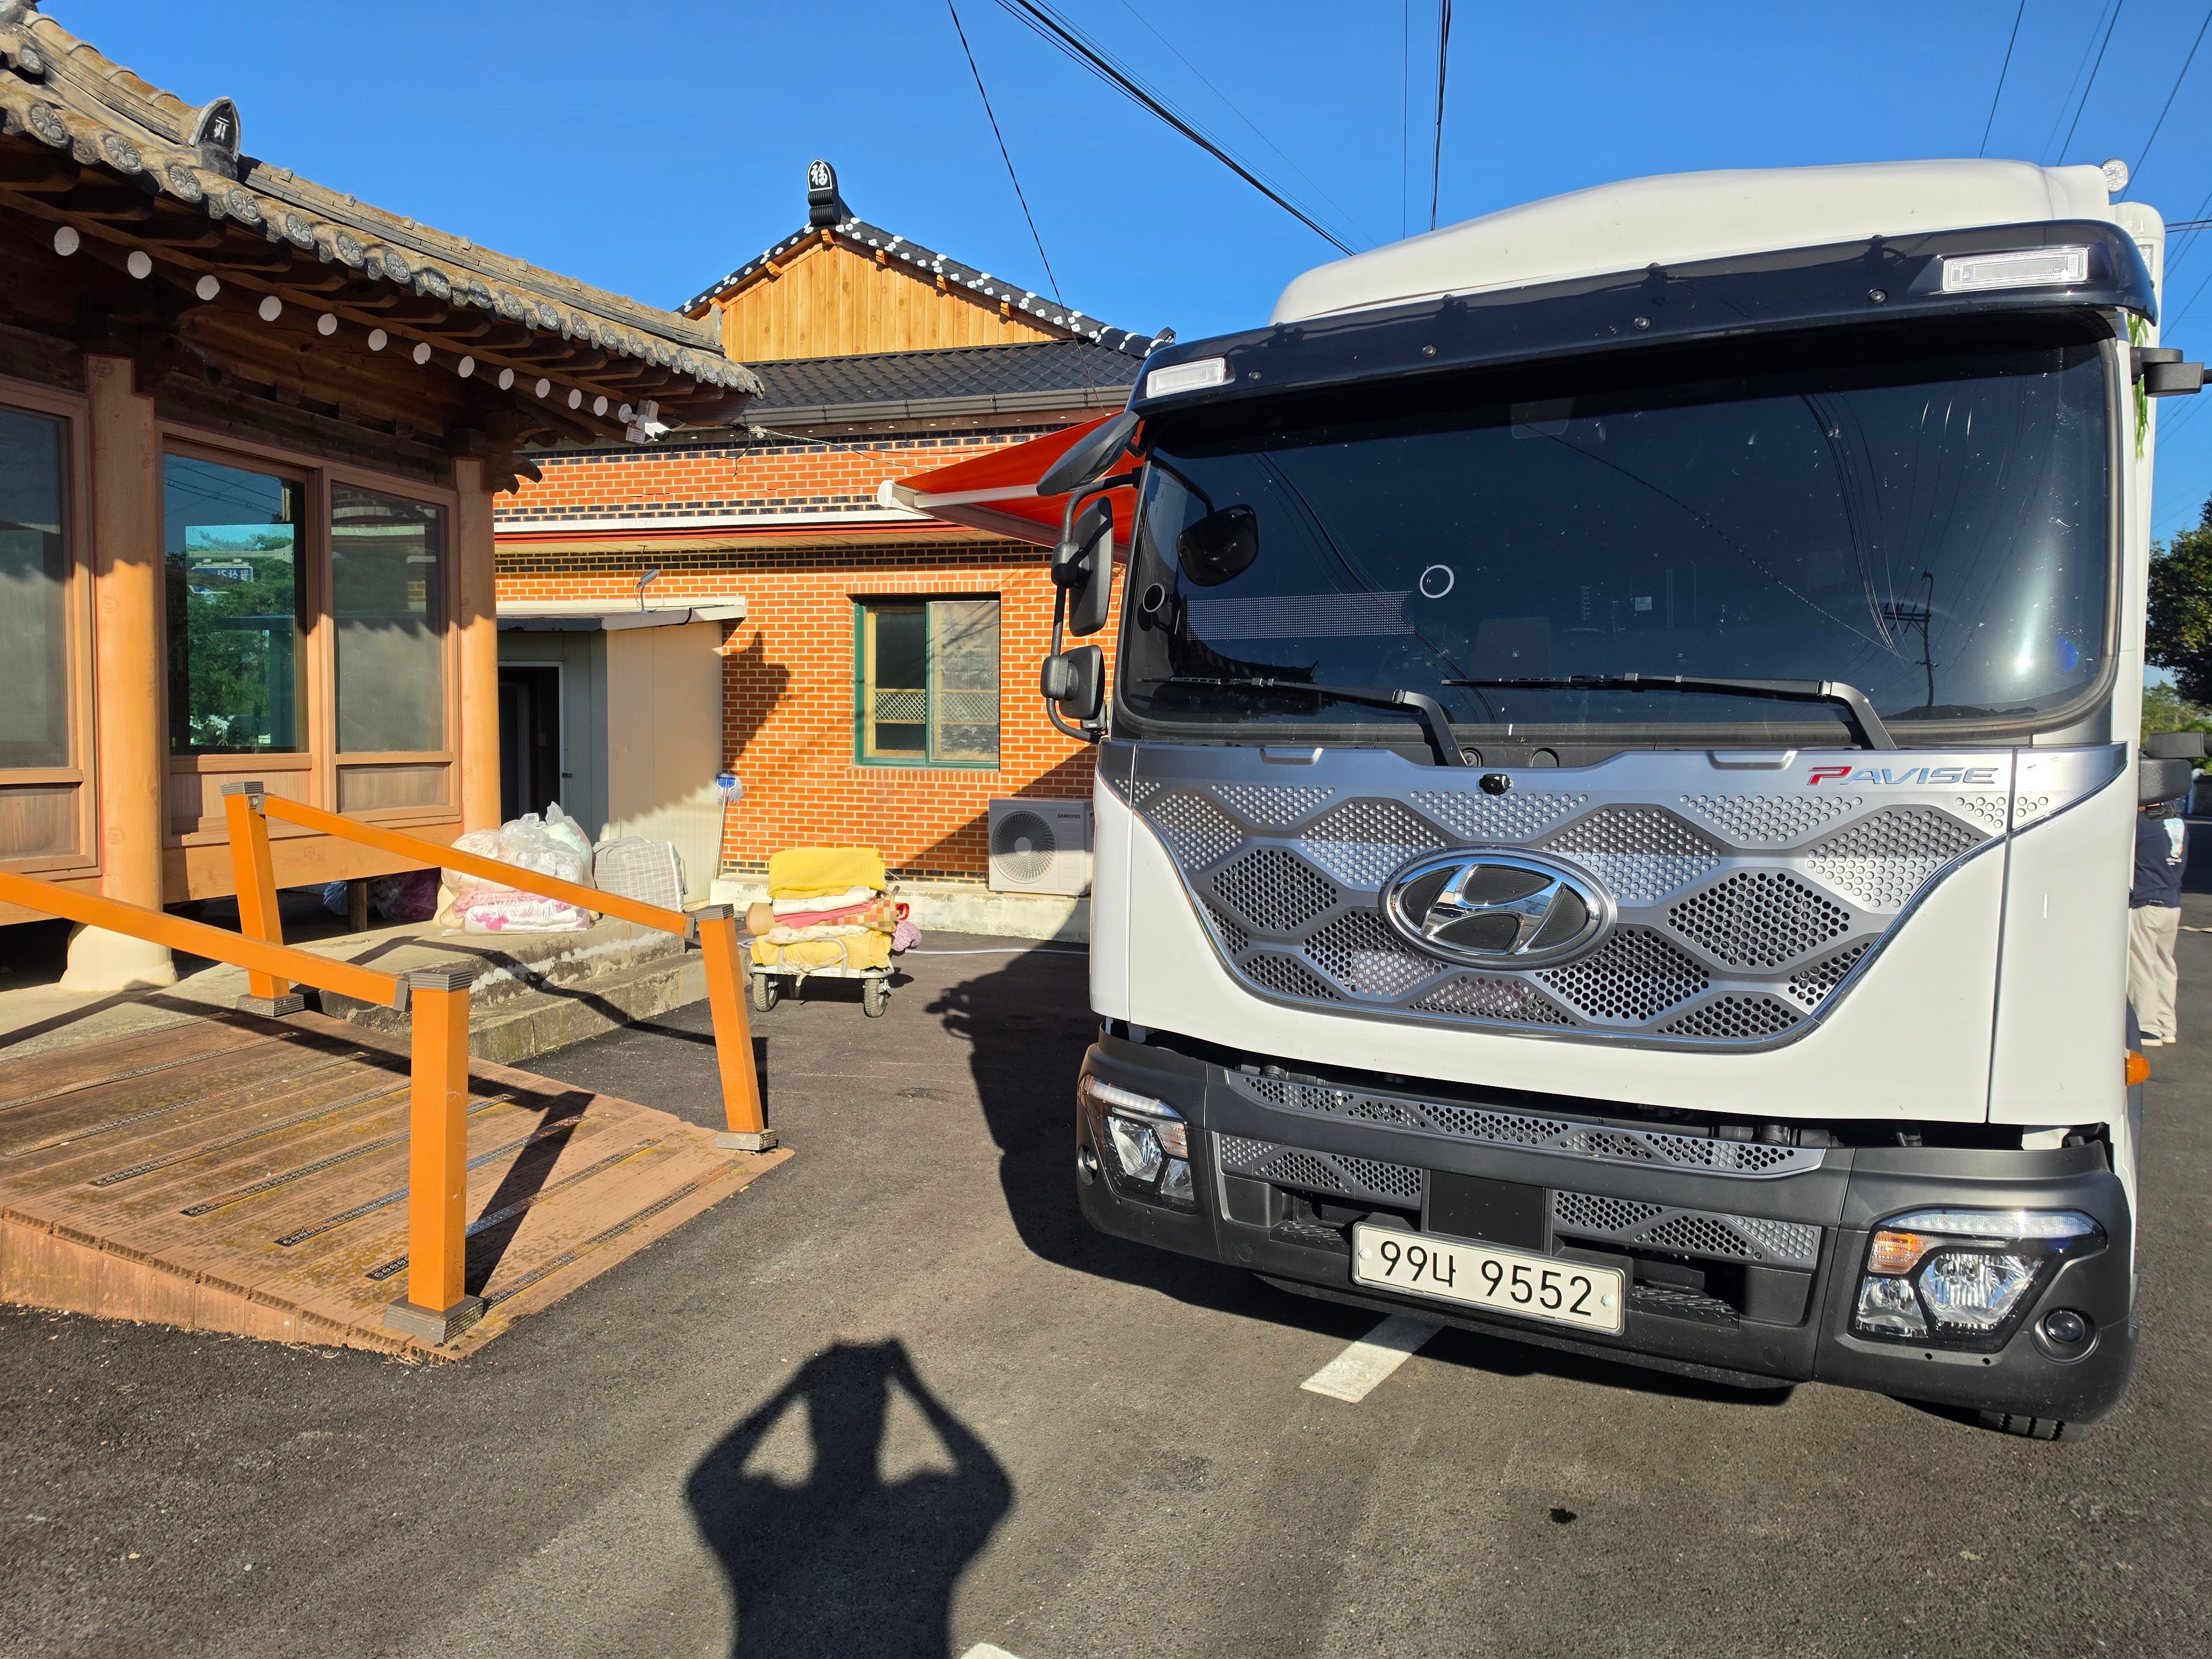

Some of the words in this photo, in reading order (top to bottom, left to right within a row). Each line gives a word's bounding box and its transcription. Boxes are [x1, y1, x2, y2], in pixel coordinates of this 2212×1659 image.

[1807, 765, 1999, 786] PAVISE
[1380, 1240, 1456, 1288] 99나
[1481, 1260, 1592, 1317] 9552
